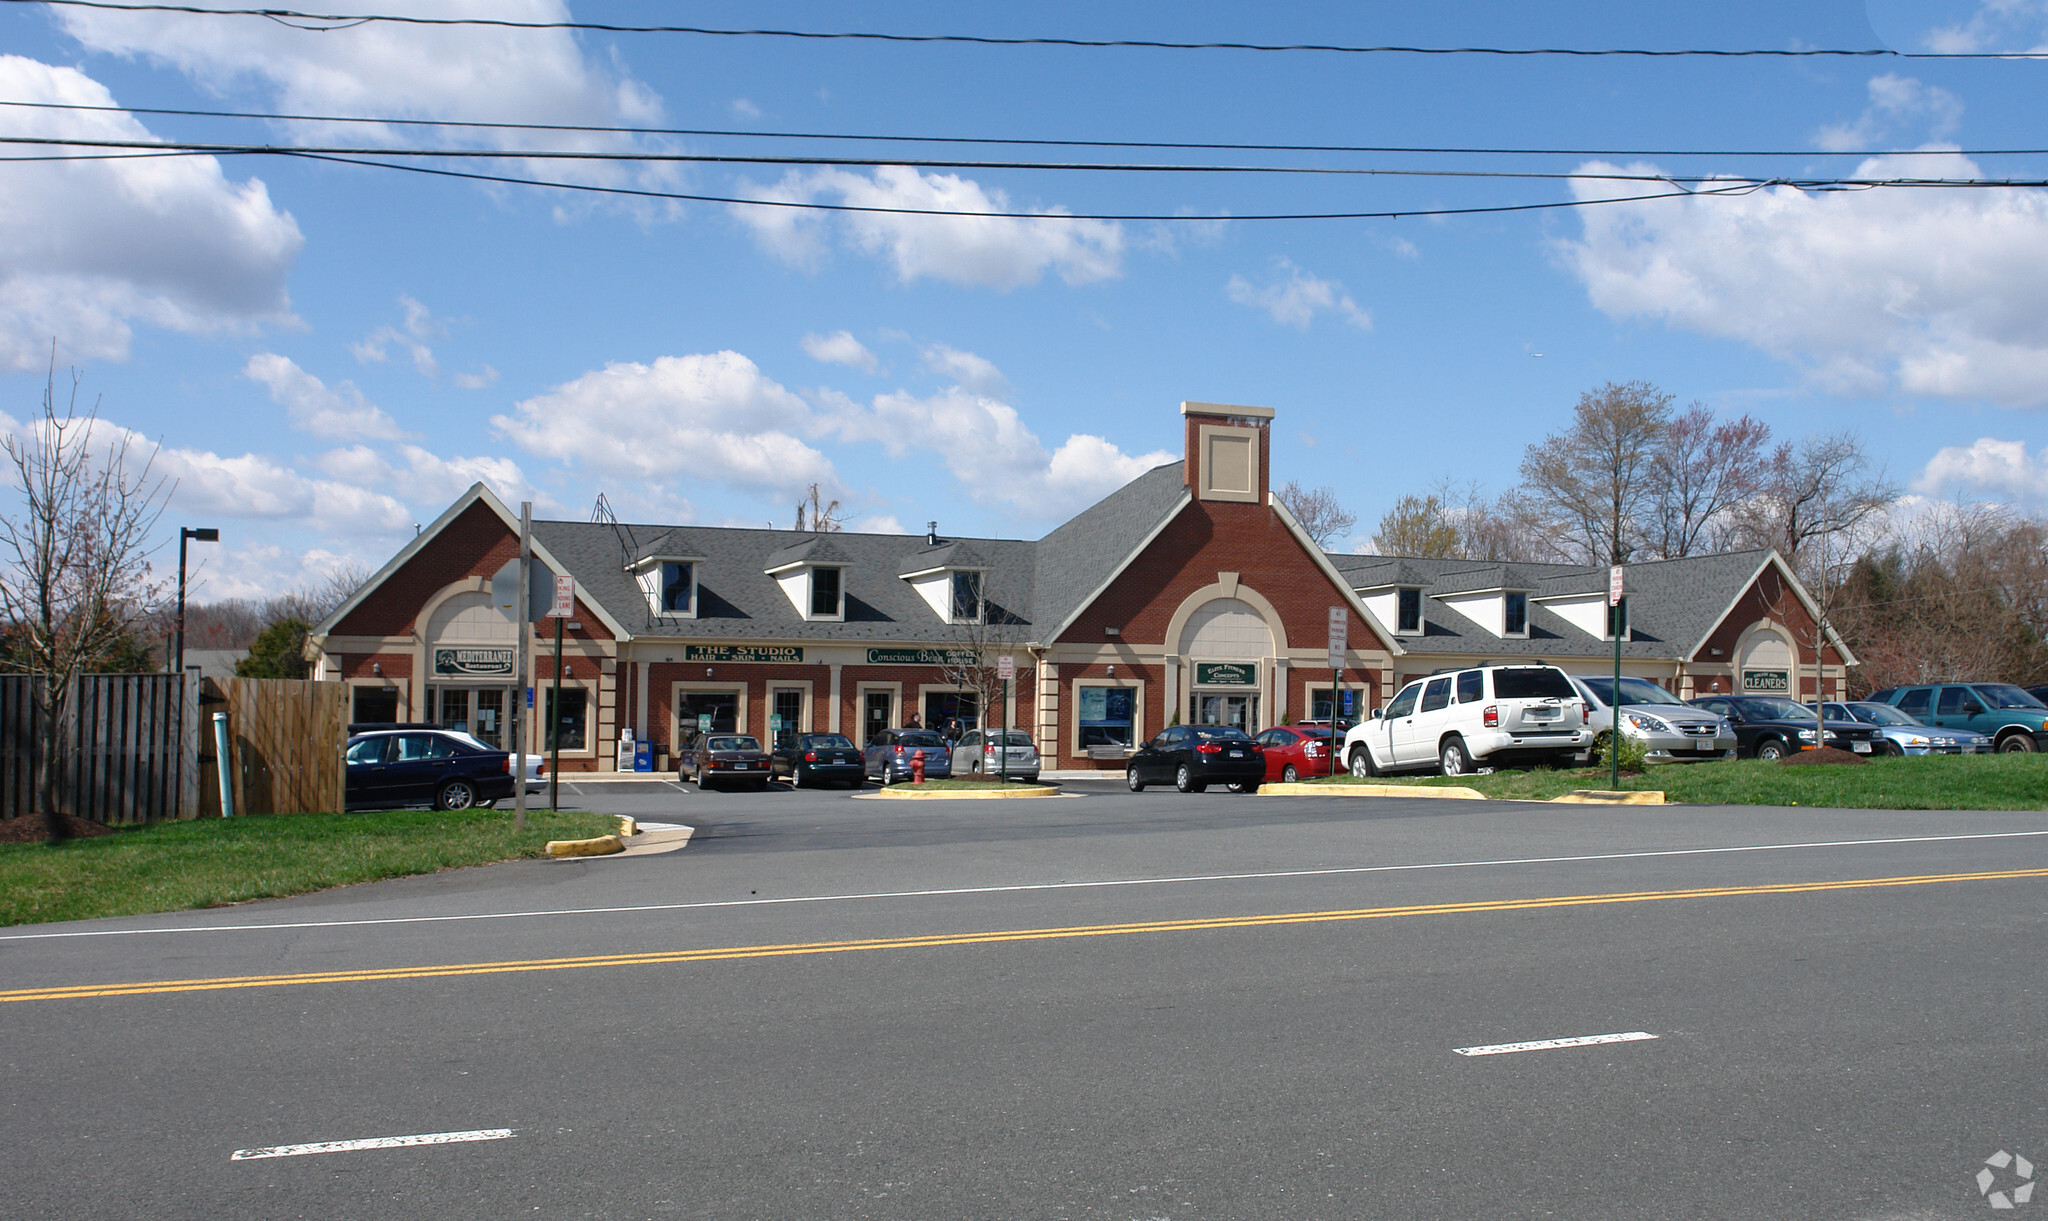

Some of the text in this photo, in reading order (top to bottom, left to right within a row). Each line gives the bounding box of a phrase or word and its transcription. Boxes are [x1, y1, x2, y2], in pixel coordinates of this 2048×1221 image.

[456, 650, 512, 662] MEDITERRANEE
[695, 646, 796, 656] THE STUDIO
[868, 649, 915, 663] Conscious
[1744, 677, 1787, 689] CLEANERS
